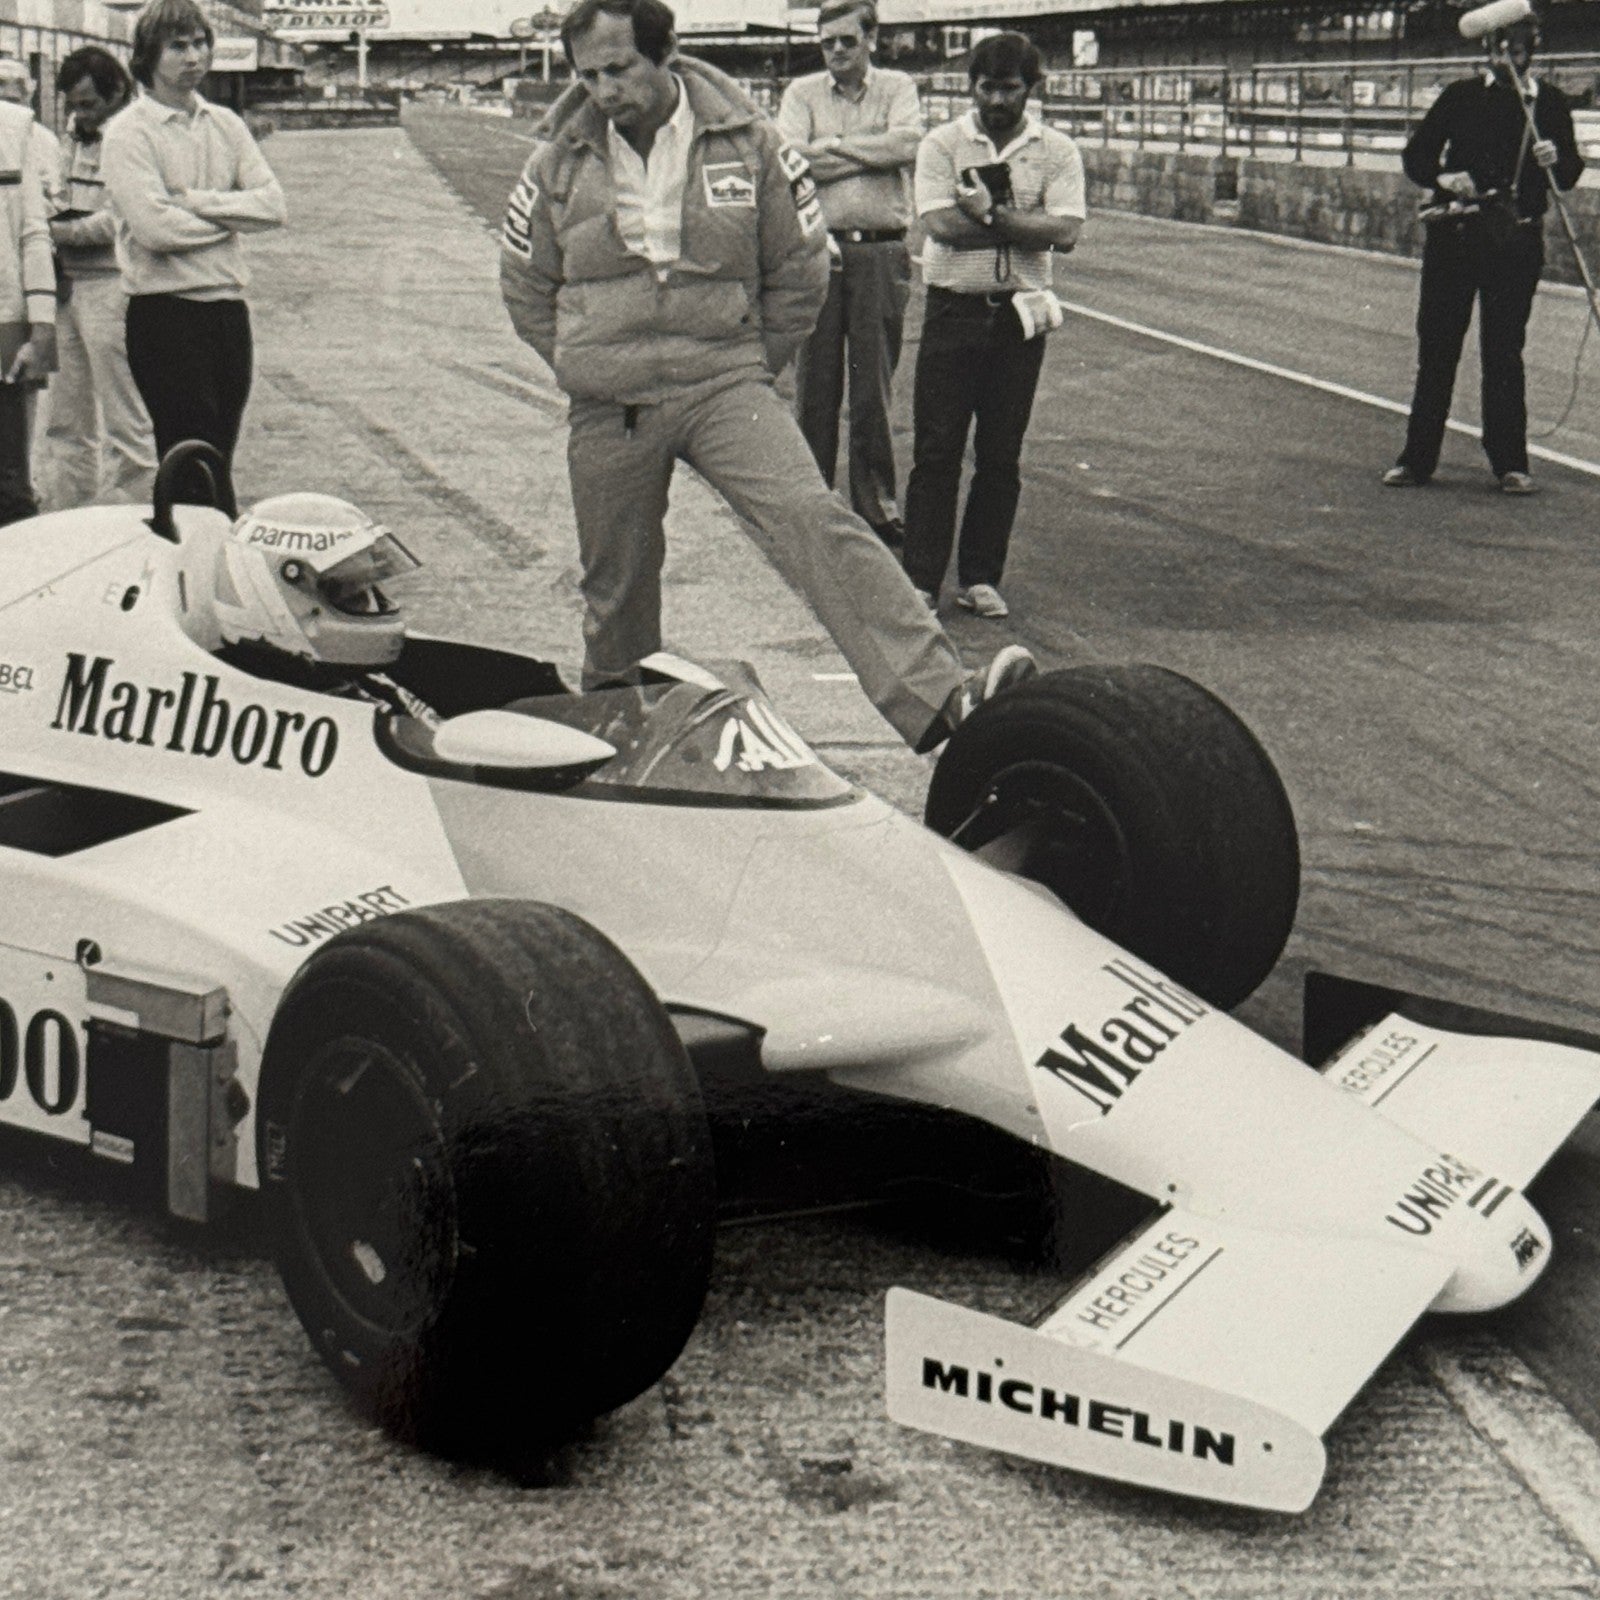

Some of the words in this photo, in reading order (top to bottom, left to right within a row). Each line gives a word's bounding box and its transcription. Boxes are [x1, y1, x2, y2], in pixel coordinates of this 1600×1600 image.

[288, 14, 384, 26] DUNLOP
[50, 652, 340, 778] Marlboro
[268, 885, 411, 947] UNIPART
[1076, 1231, 1200, 1331] HERCULES
[921, 1356, 1236, 1467] MICHELIN
